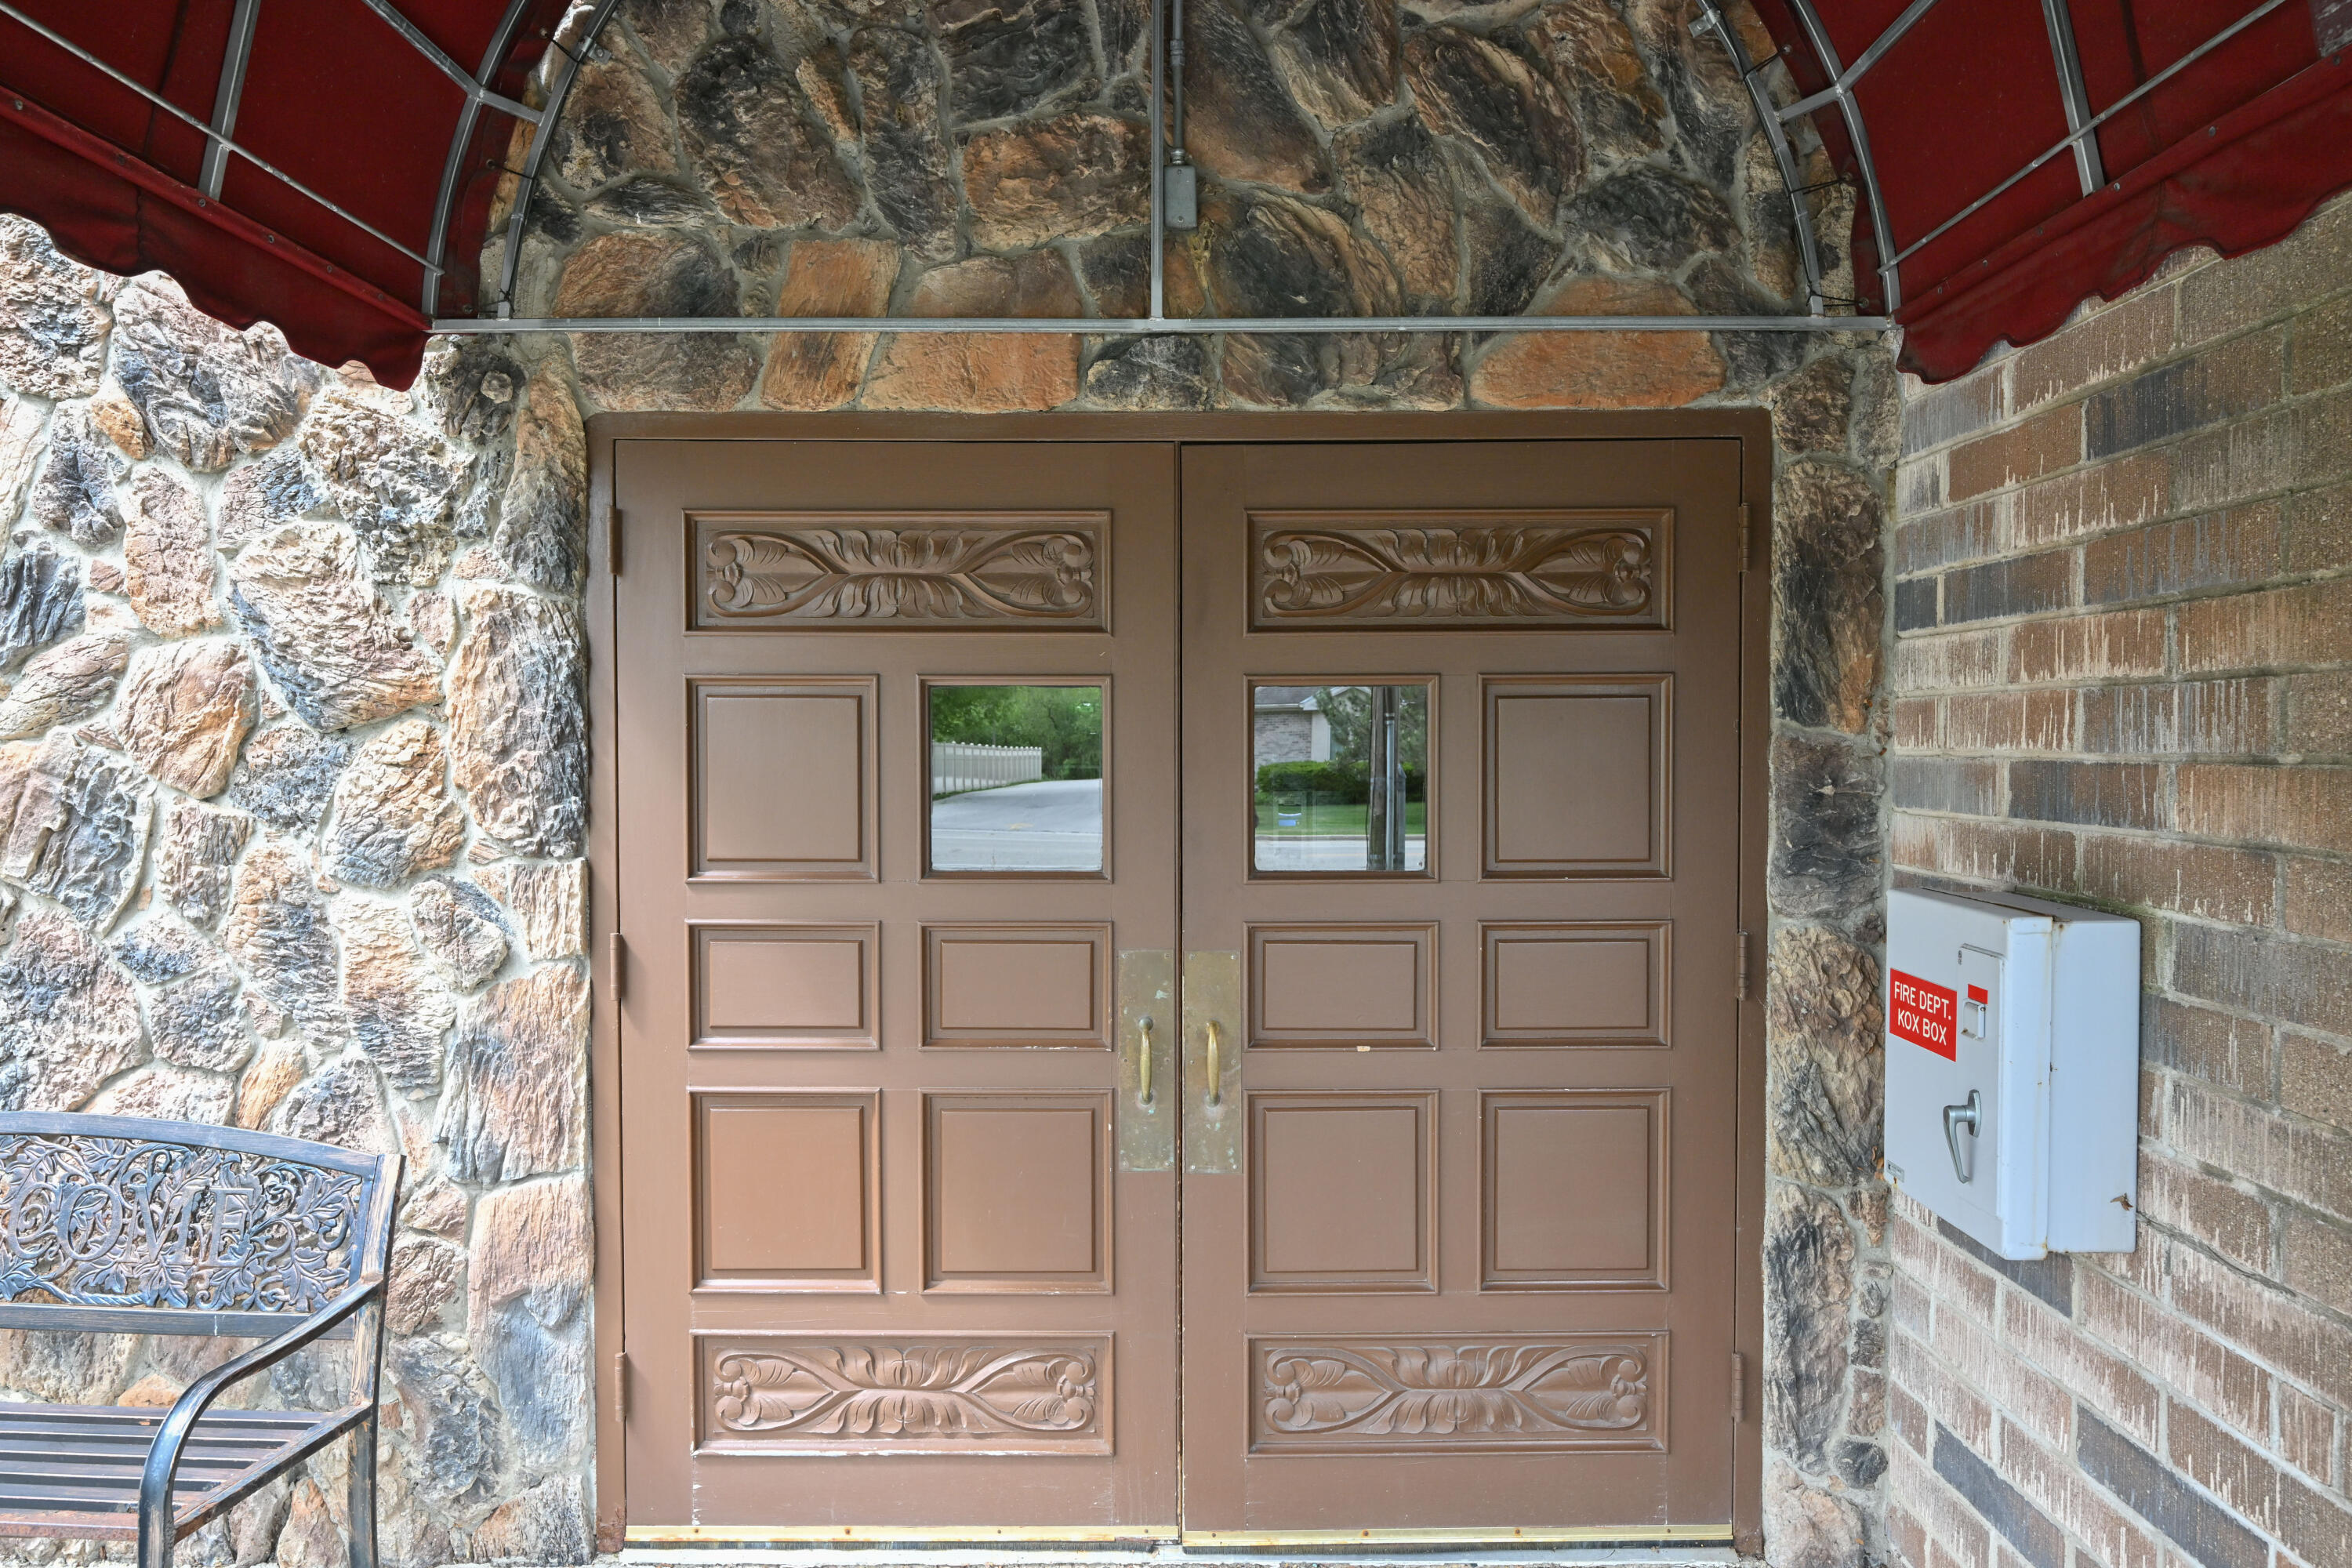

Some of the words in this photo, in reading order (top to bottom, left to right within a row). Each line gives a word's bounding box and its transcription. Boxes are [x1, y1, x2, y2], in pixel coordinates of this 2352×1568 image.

[1894, 981, 1916, 1007] FIRE
[1919, 990, 1951, 1020] DEPT.
[1898, 1008, 1919, 1034] KOX
[1922, 1018, 1947, 1046] BOX
